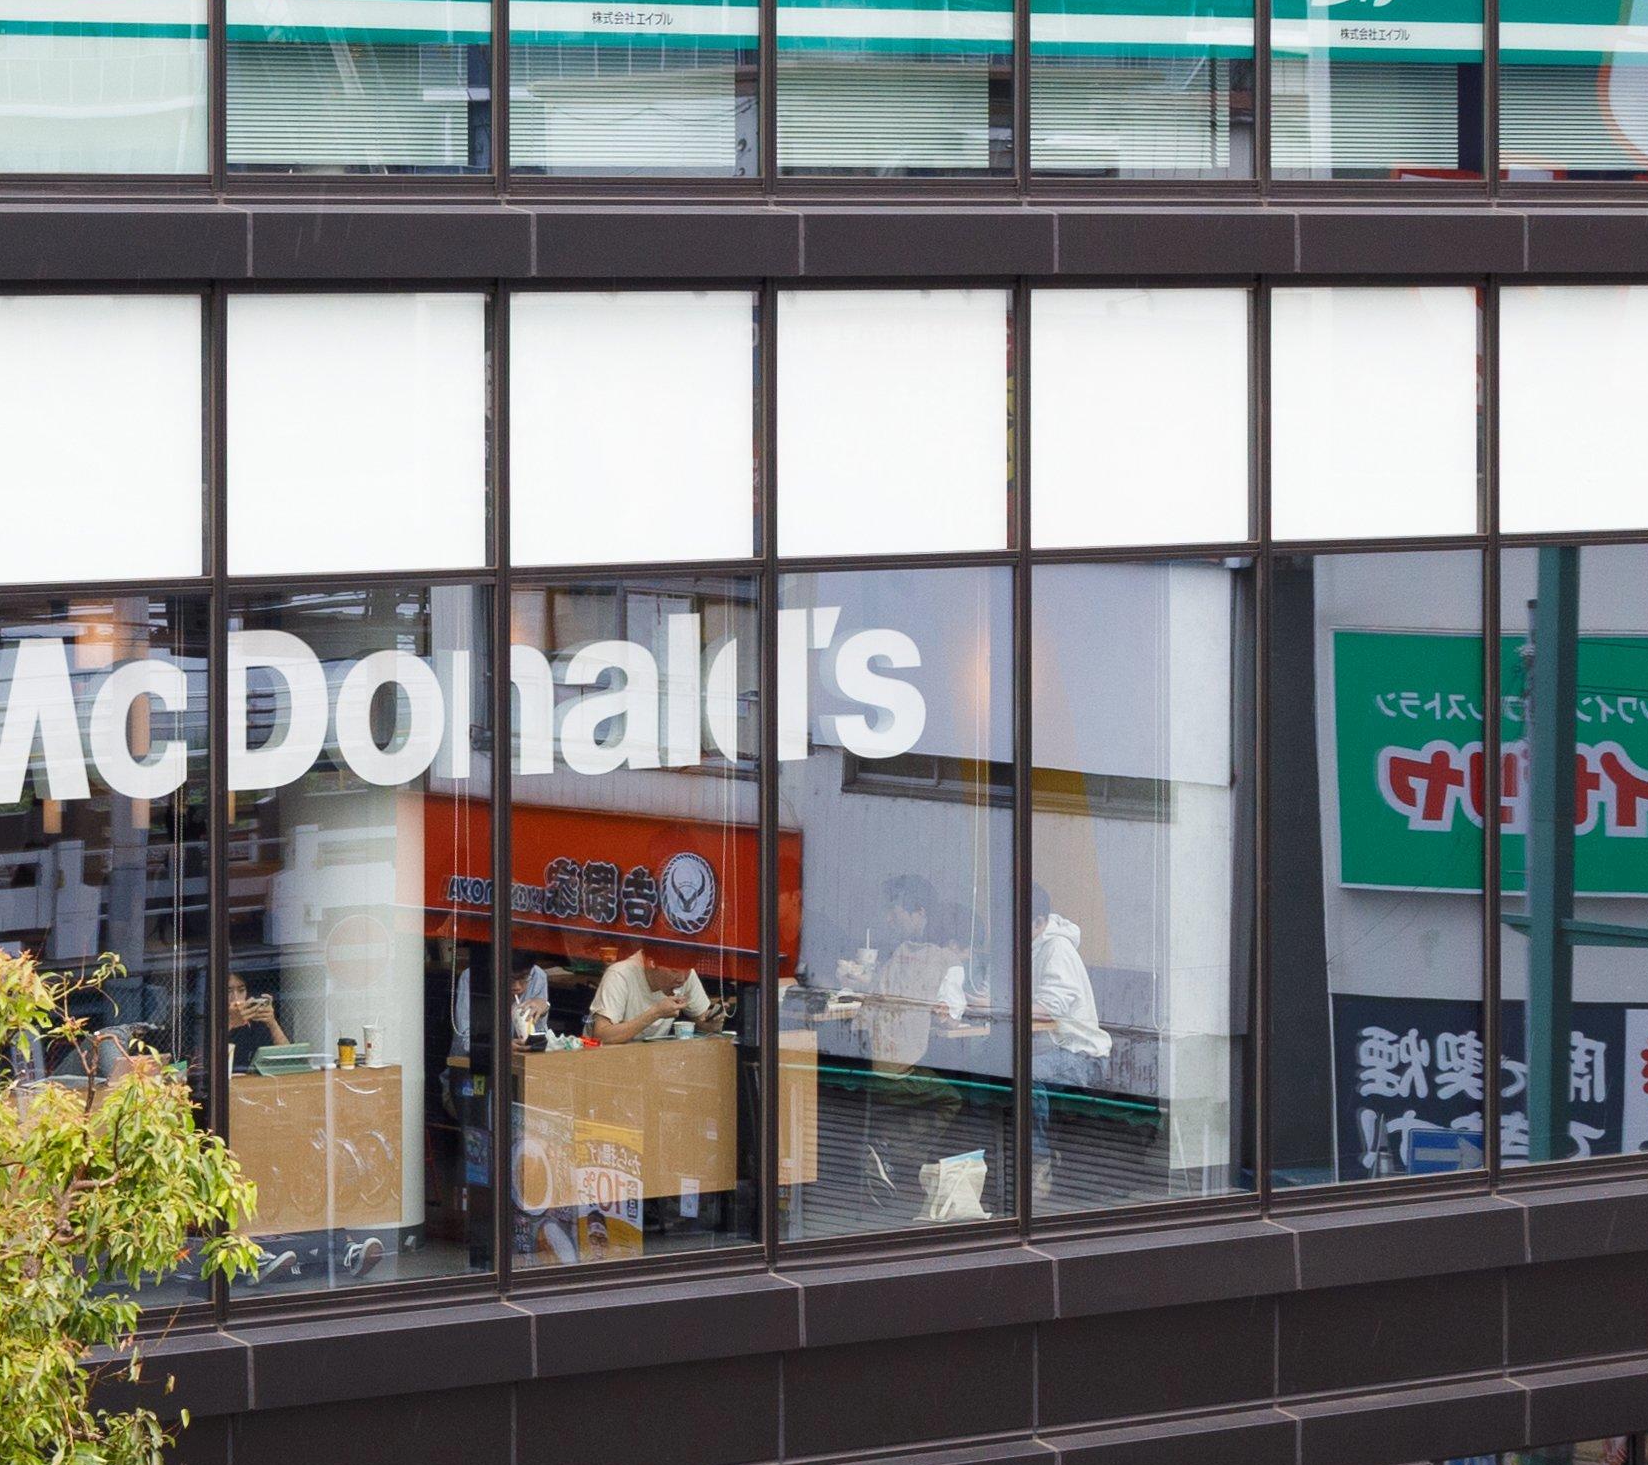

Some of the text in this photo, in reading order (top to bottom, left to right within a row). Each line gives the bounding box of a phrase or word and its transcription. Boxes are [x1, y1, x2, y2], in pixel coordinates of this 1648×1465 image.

[591, 11, 674, 28] 株式会社エイブル
